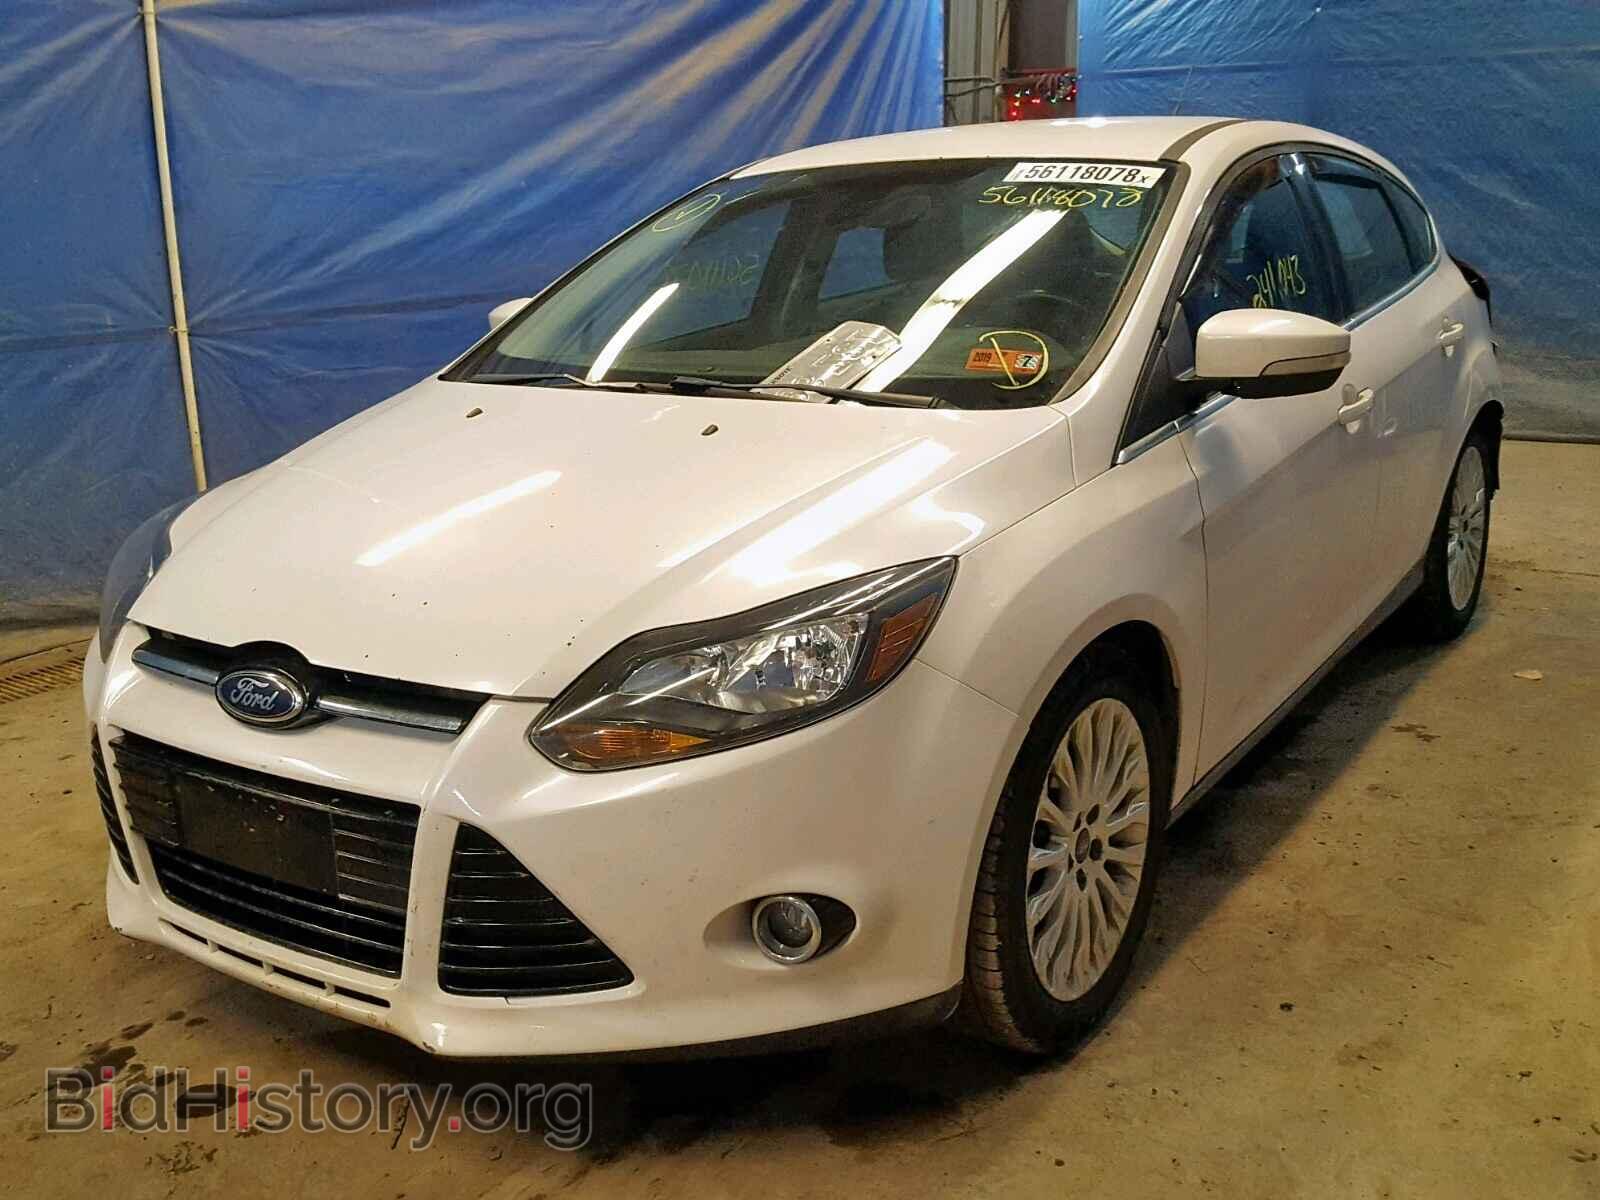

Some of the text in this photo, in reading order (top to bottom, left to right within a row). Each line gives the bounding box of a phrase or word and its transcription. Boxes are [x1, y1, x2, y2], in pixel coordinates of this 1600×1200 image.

[1024, 165, 1141, 183] 56118078
[1022, 355, 1033, 367] 7
[230, 677, 280, 711] Ford
